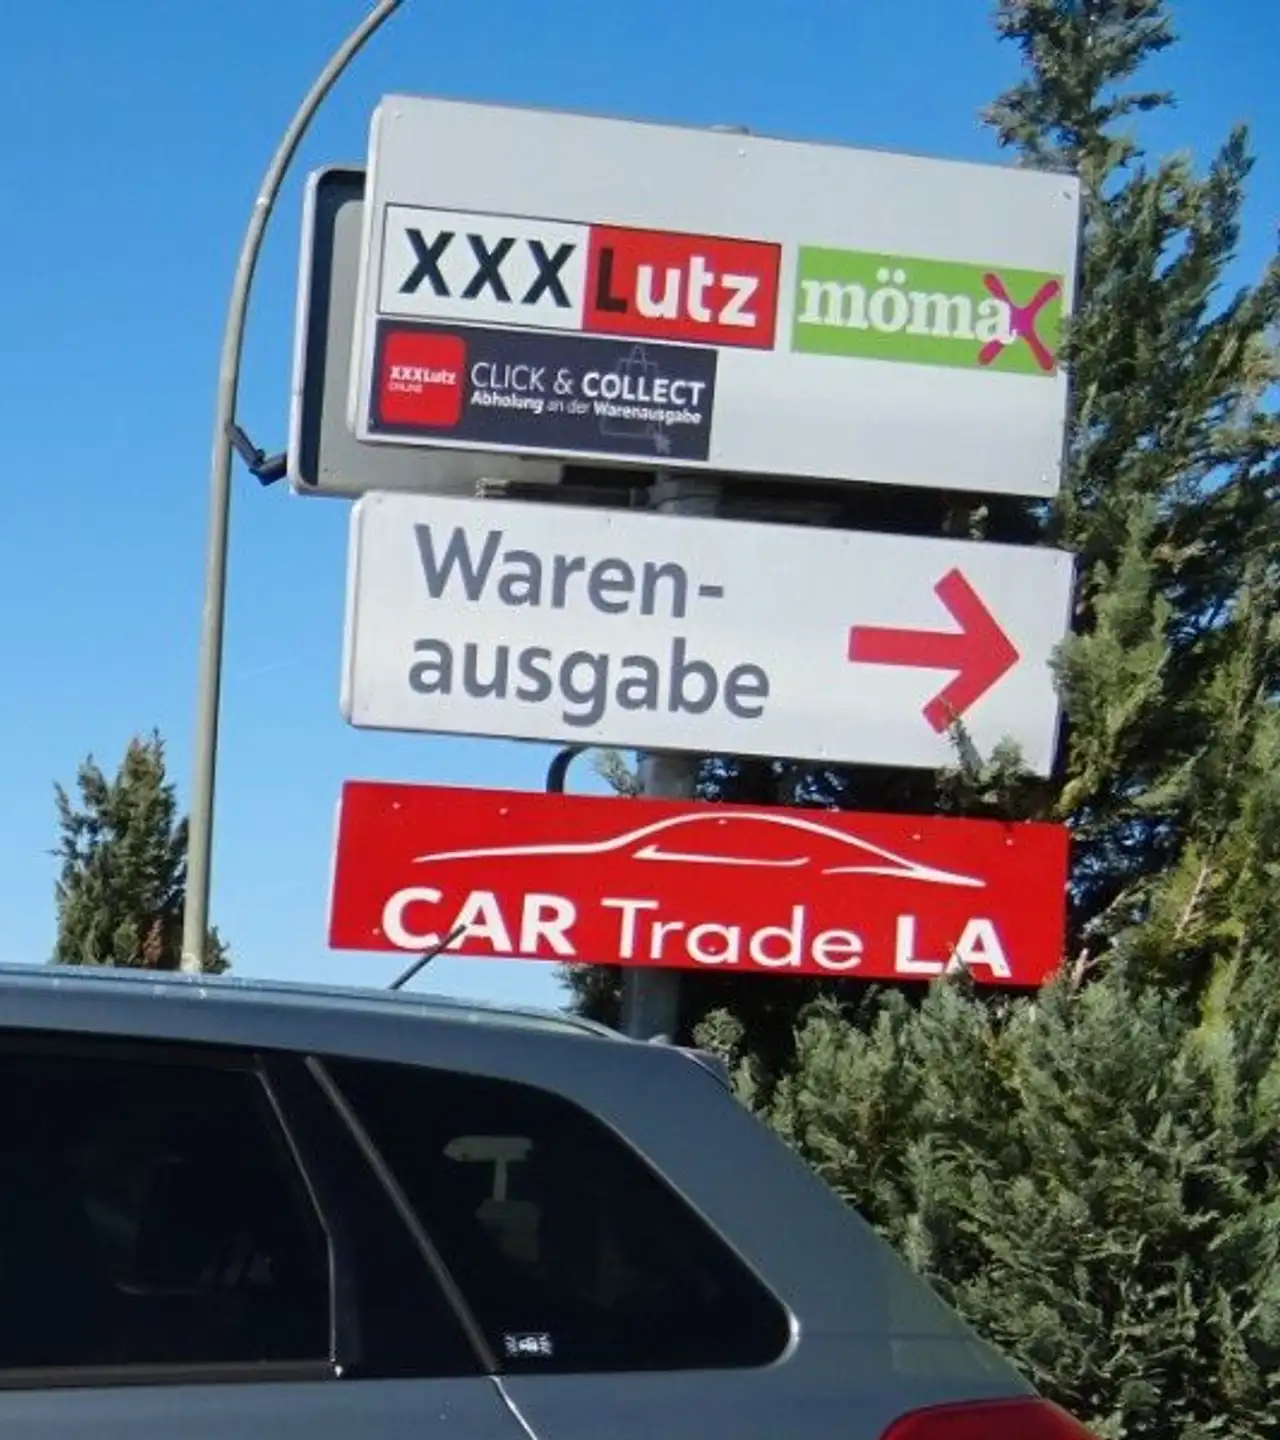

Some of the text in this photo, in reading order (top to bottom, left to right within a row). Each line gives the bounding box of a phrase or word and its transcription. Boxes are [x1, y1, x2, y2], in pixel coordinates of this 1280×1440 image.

[470, 361, 706, 407] CLICK & COLLECT
[470, 389, 703, 426] Abholung an der Warenausgabe
[413, 521, 725, 619] Waren-
[407, 636, 771, 728] ausgabe
[382, 886, 1013, 978] CAR Trade LA
